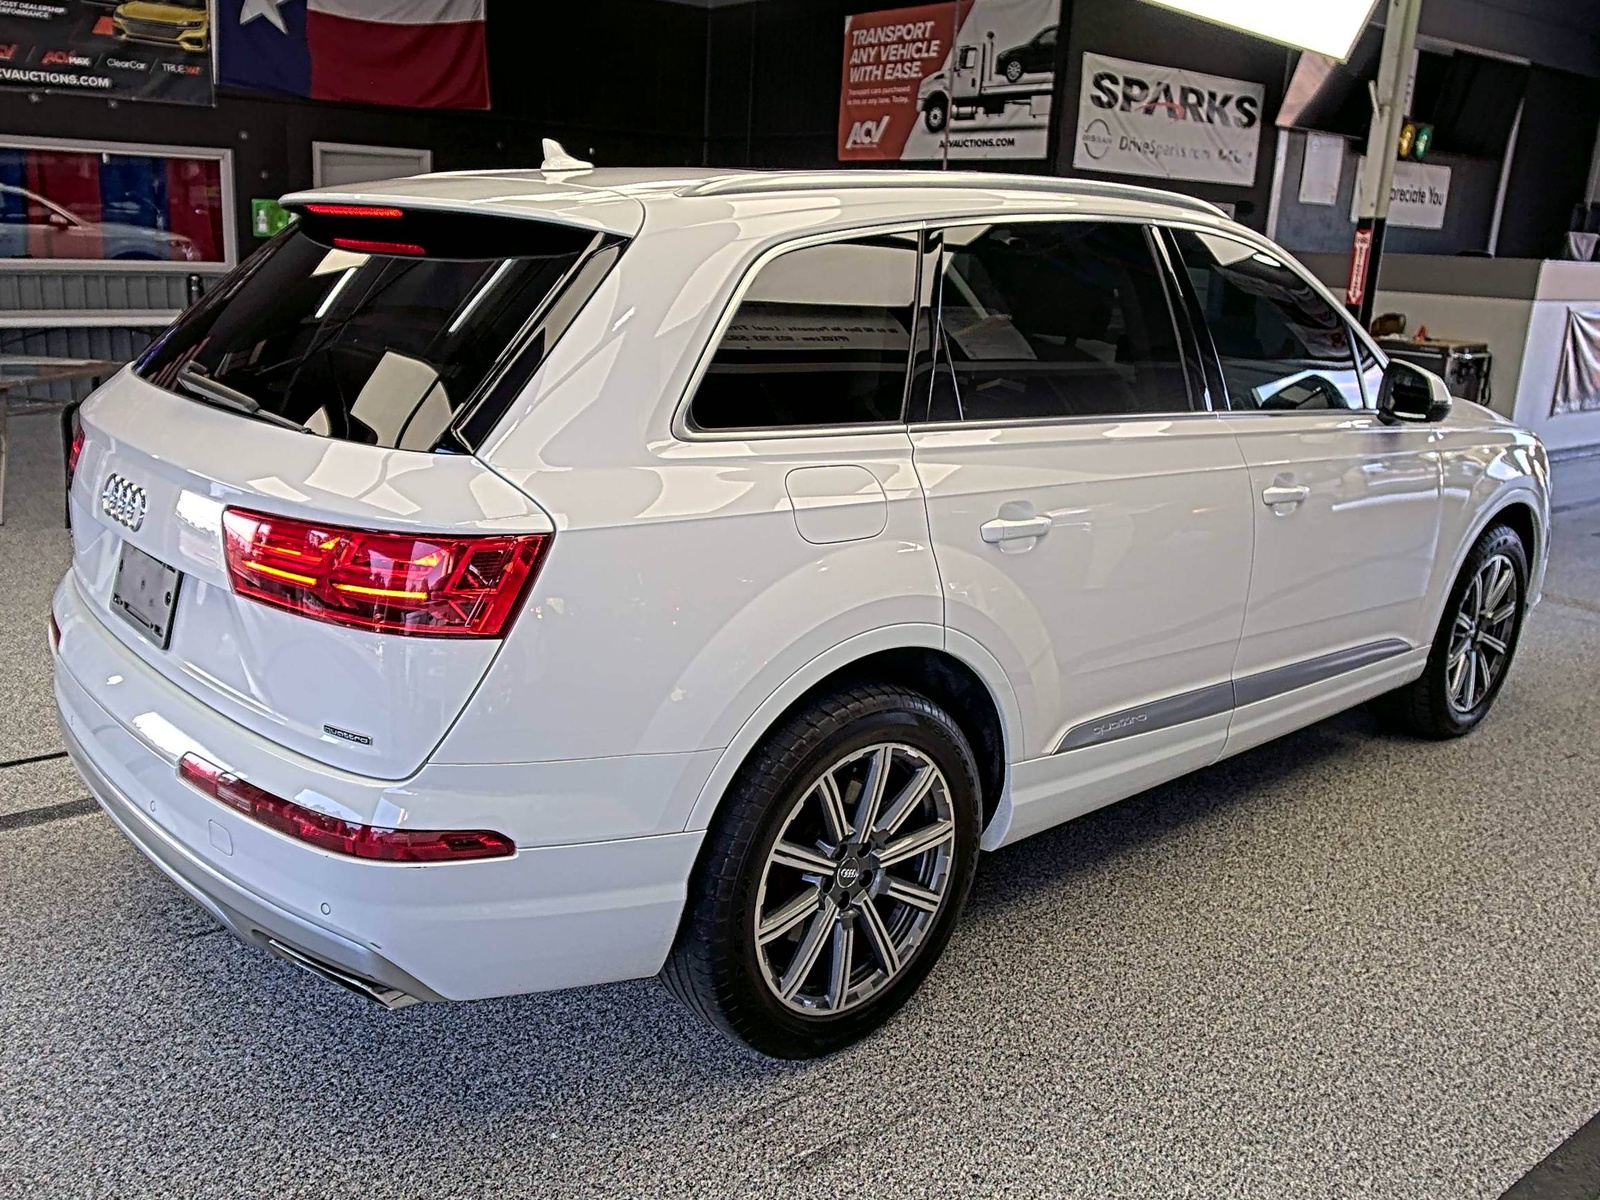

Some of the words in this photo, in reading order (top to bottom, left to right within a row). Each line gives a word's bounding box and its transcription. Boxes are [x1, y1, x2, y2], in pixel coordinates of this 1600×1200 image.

[852, 21, 935, 46] TRANSPORT
[849, 46, 878, 65] ANY
[881, 40, 940, 61] VEHICLE
[106, 58, 147, 70] ClearCar
[849, 64, 884, 83] WITH
[884, 61, 922, 80] EASE.
[0, 67, 110, 88] VAUCTIONS.COM
[1090, 71, 1258, 129] SPARKS
[845, 115, 890, 150] ACV
[939, 138, 1015, 148] AVAUCTIONS.COM
[1429, 186, 1444, 206] You
[324, 726, 369, 744] quattro
[1093, 714, 1147, 736] quattro
